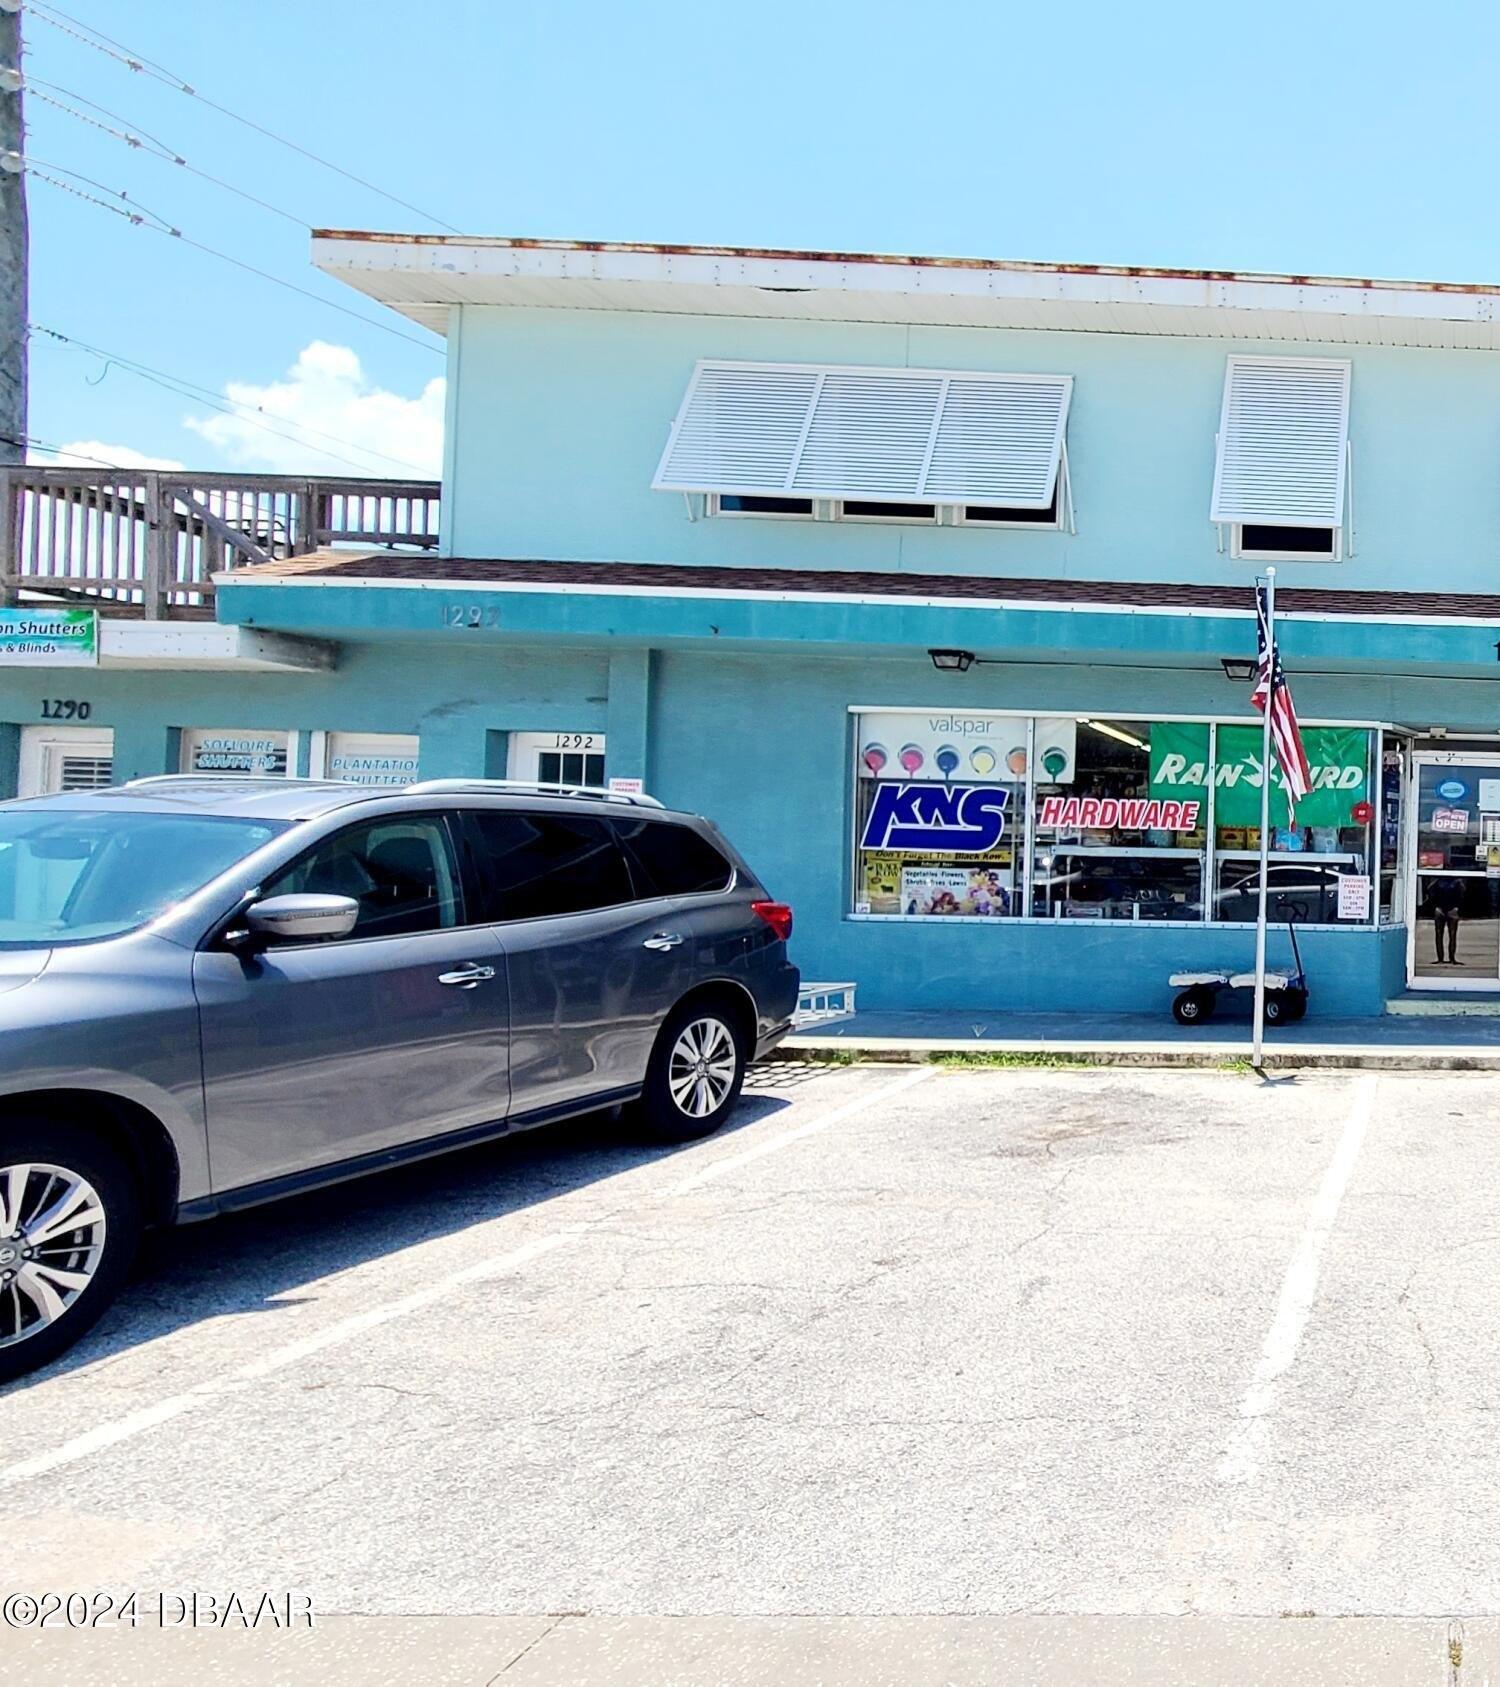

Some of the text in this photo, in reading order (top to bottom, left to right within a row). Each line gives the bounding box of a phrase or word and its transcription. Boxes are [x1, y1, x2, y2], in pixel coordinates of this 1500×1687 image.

[18, 621, 86, 635] Shutters
[6, 642, 56, 653] & Blinds
[41, 699, 90, 719] 1290
[929, 715, 994, 736] valspar
[556, 734, 593, 749] 1292
[200, 754, 276, 769] SHUTTERS
[333, 759, 419, 771] PLANTATIO
[860, 783, 1010, 853] KNS
[1040, 797, 1199, 831] HARDWARE
[1435, 819, 1465, 830] OPEN
